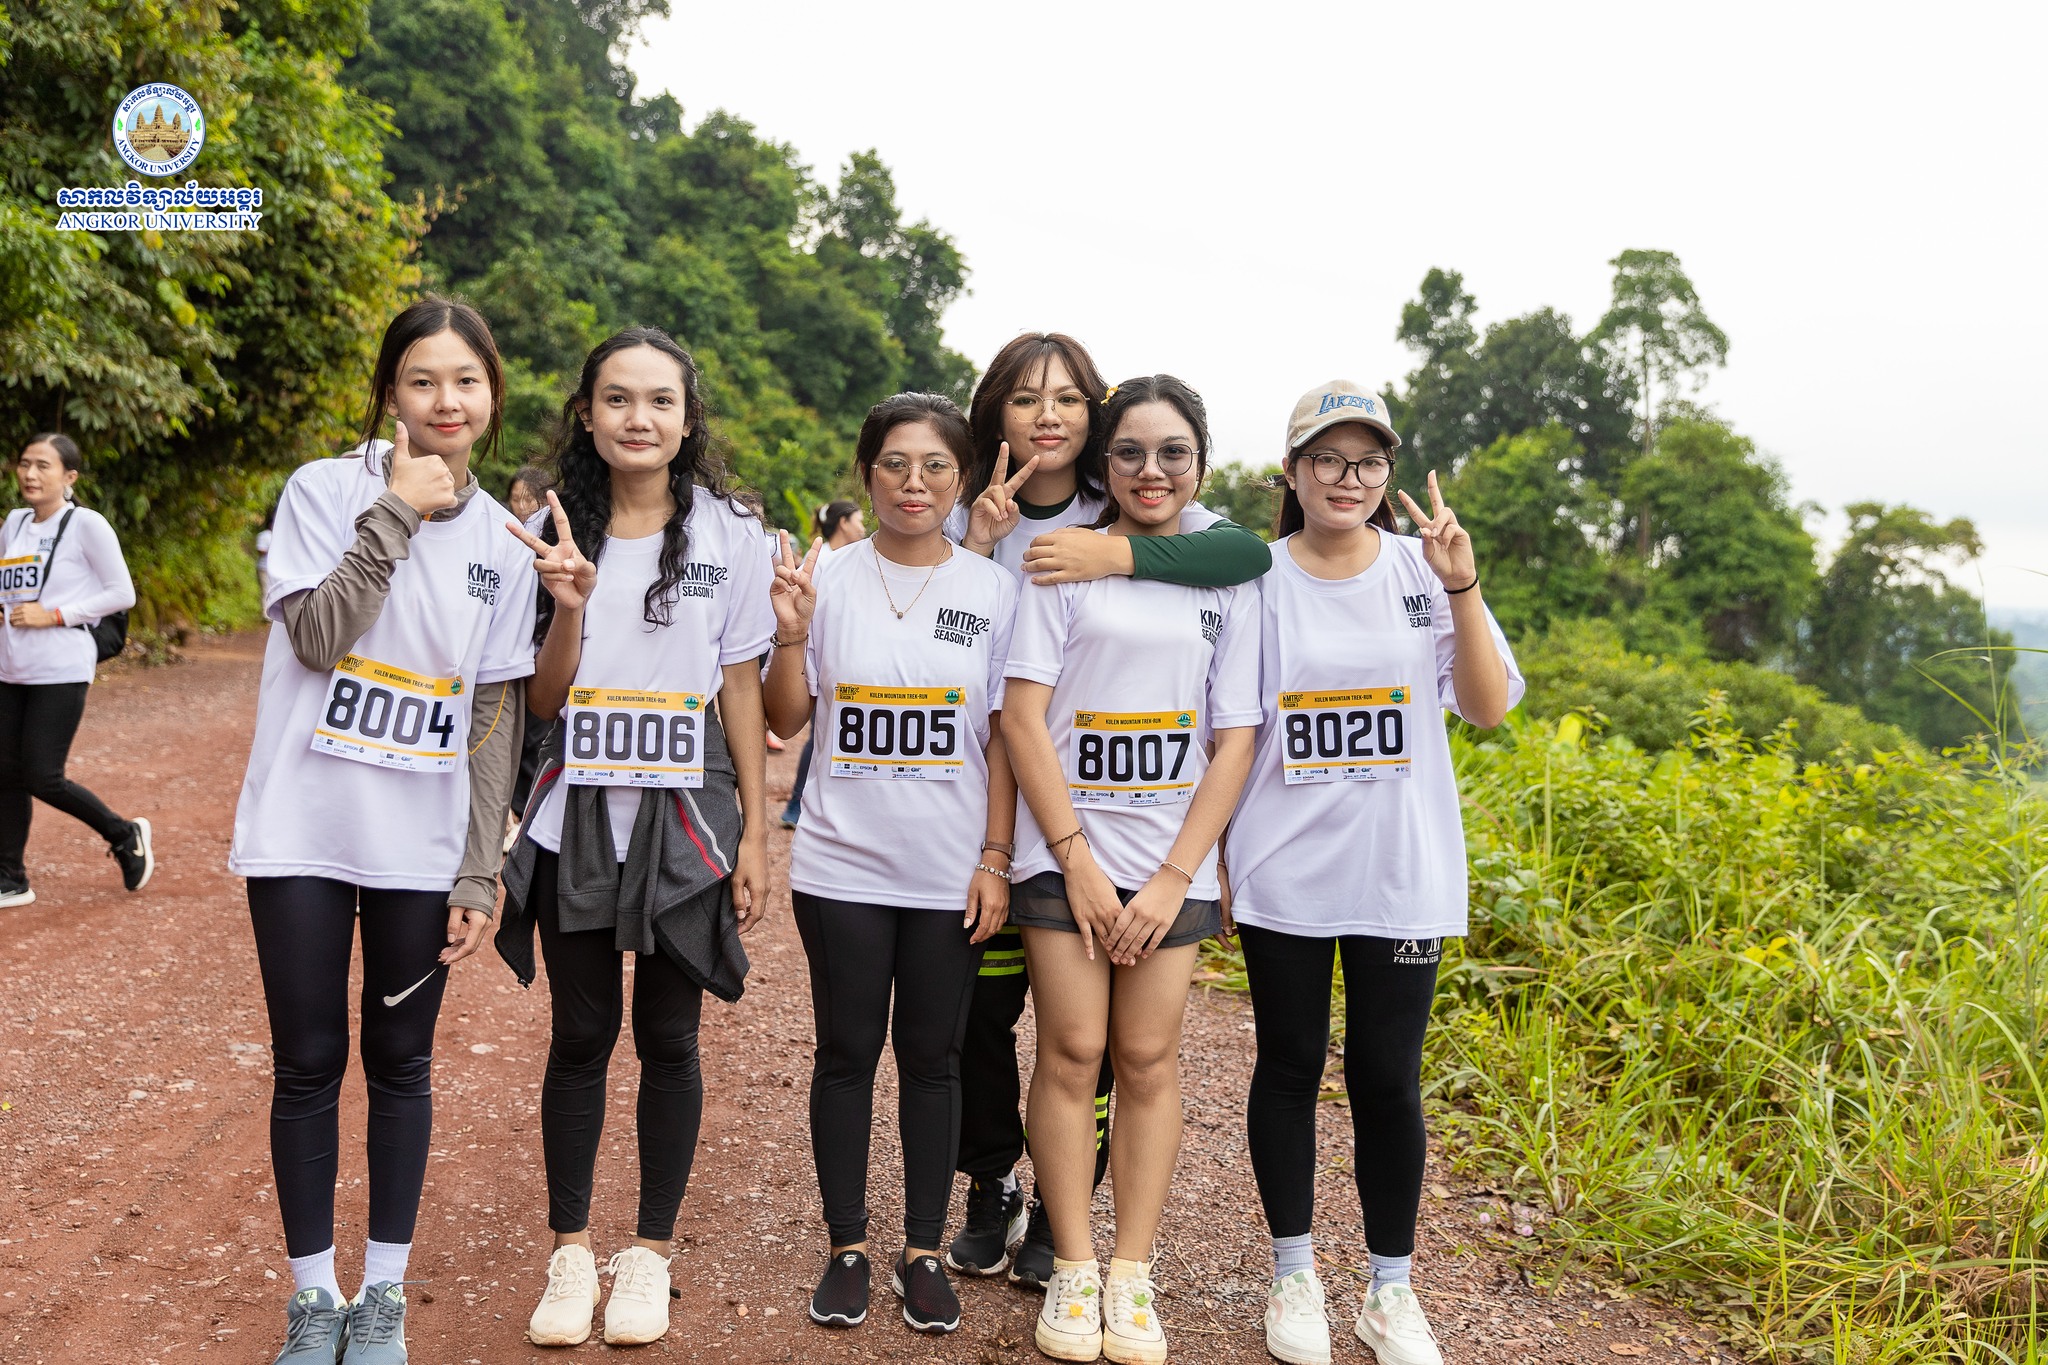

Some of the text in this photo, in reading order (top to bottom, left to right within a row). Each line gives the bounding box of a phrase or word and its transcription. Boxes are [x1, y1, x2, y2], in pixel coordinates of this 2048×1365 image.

[1315, 392, 1376, 416] LAKERS
[0, 566, 38, 590] 063
[489, 594, 495, 606] 3
[682, 586, 710, 599] SEASON
[933, 629, 973, 648] SEASON 3
[374, 669, 388, 677] KULEN
[389, 673, 411, 685] MOUNTAIN
[326, 677, 455, 748] 8004
[572, 711, 695, 763] 8006
[839, 706, 956, 756] 8005
[1286, 709, 1403, 759] 8020
[1078, 733, 1191, 782] 8007
[1393, 956, 1428, 964] FASHION
